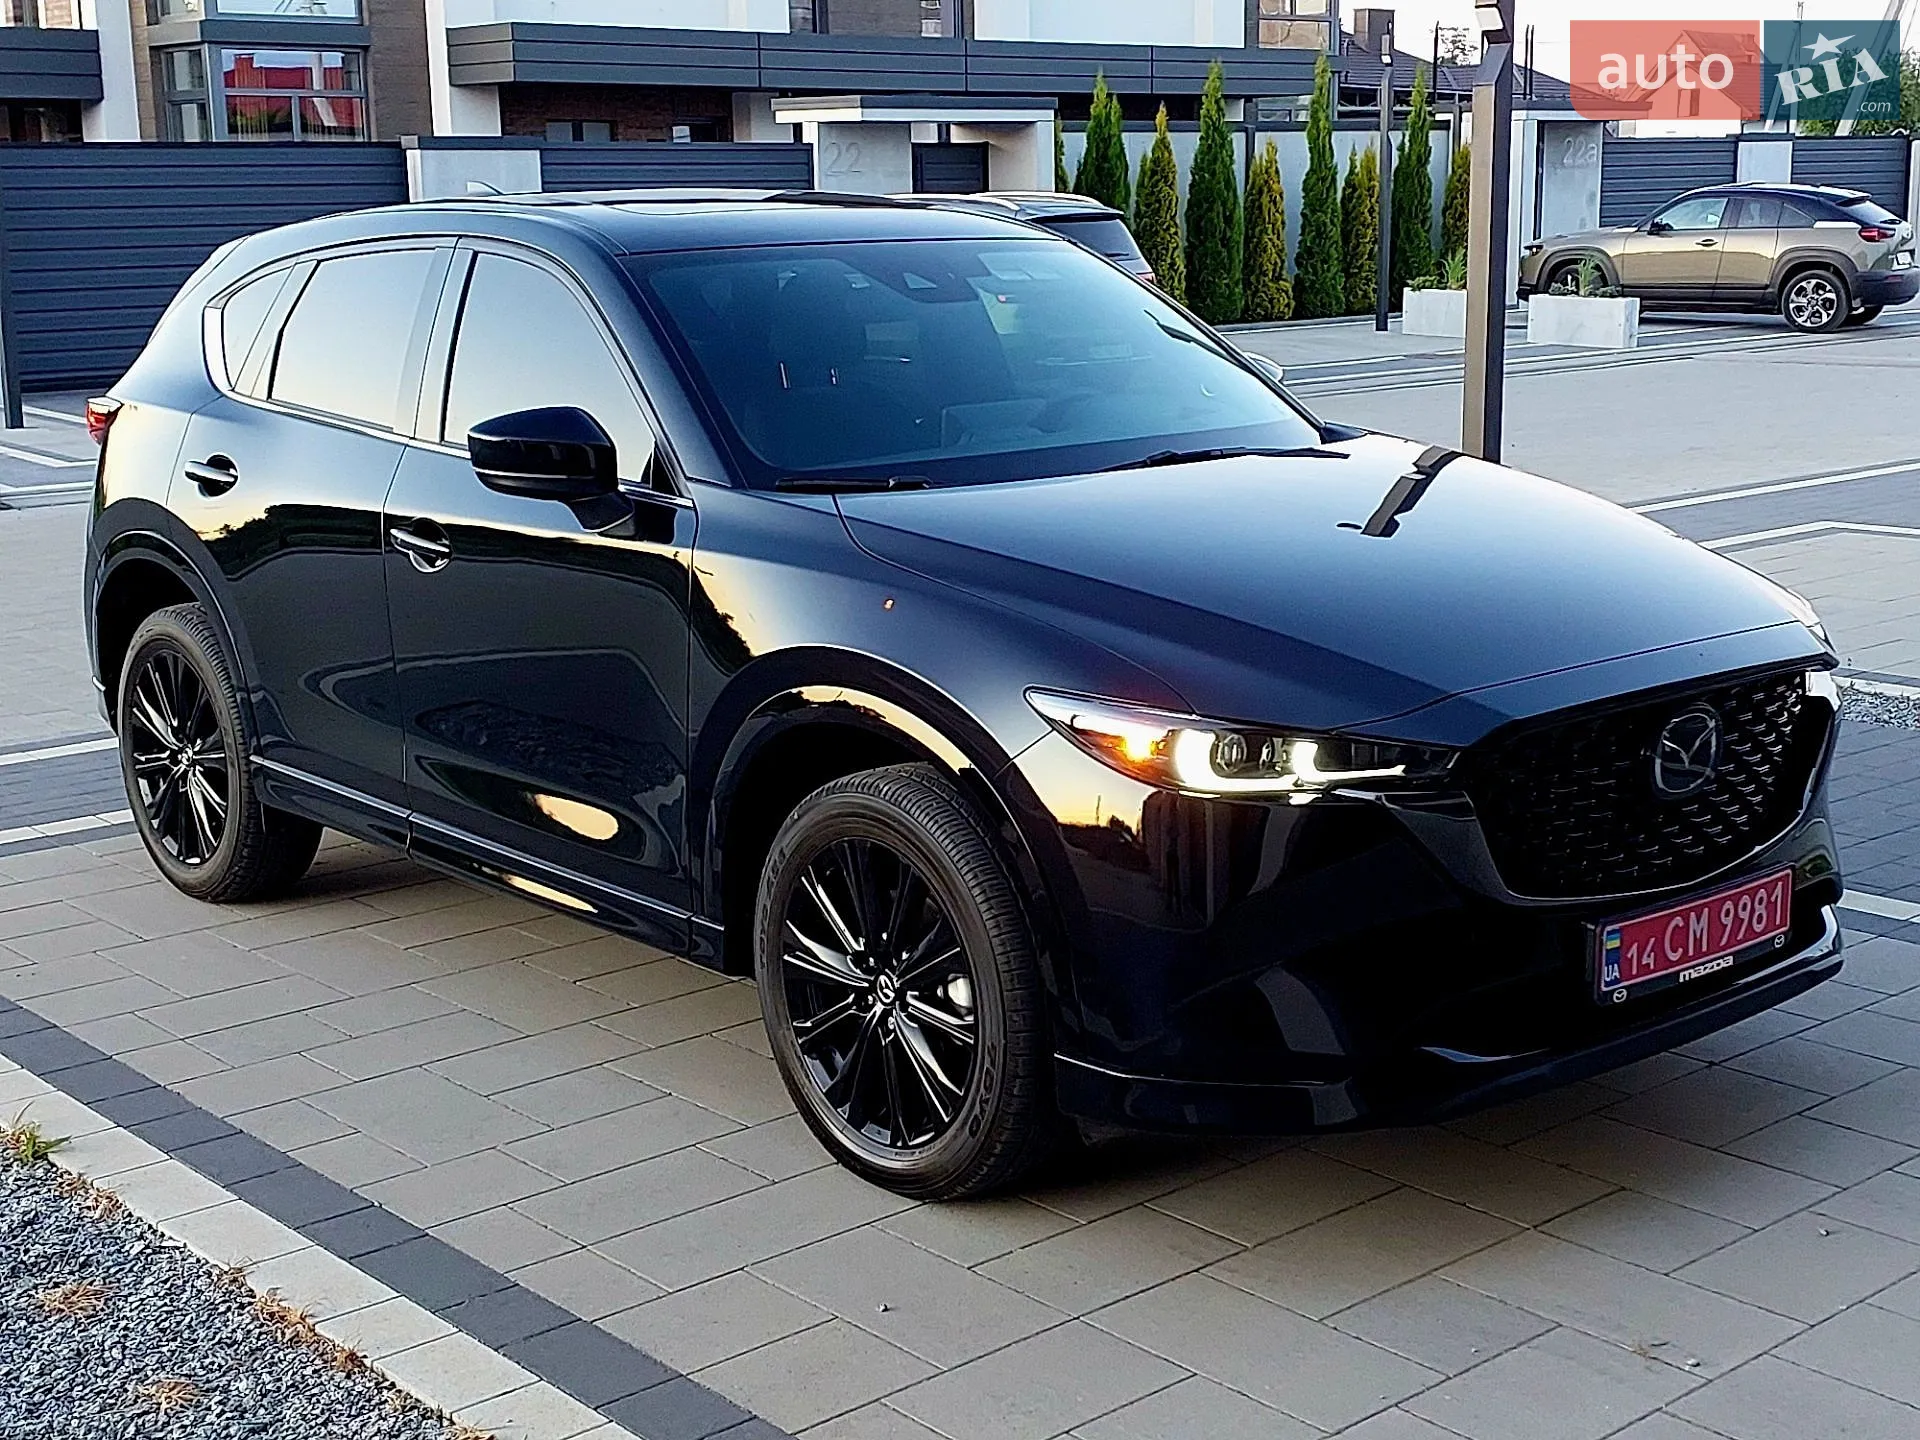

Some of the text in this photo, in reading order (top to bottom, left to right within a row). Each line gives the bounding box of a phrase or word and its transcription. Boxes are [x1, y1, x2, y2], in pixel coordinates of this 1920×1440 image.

[825, 142, 863, 176] 22
[1563, 135, 1598, 167] 22a
[1626, 881, 1784, 976] 14 CM 9981
[1604, 963, 1620, 981] UA
[1679, 955, 1734, 983] mazda
